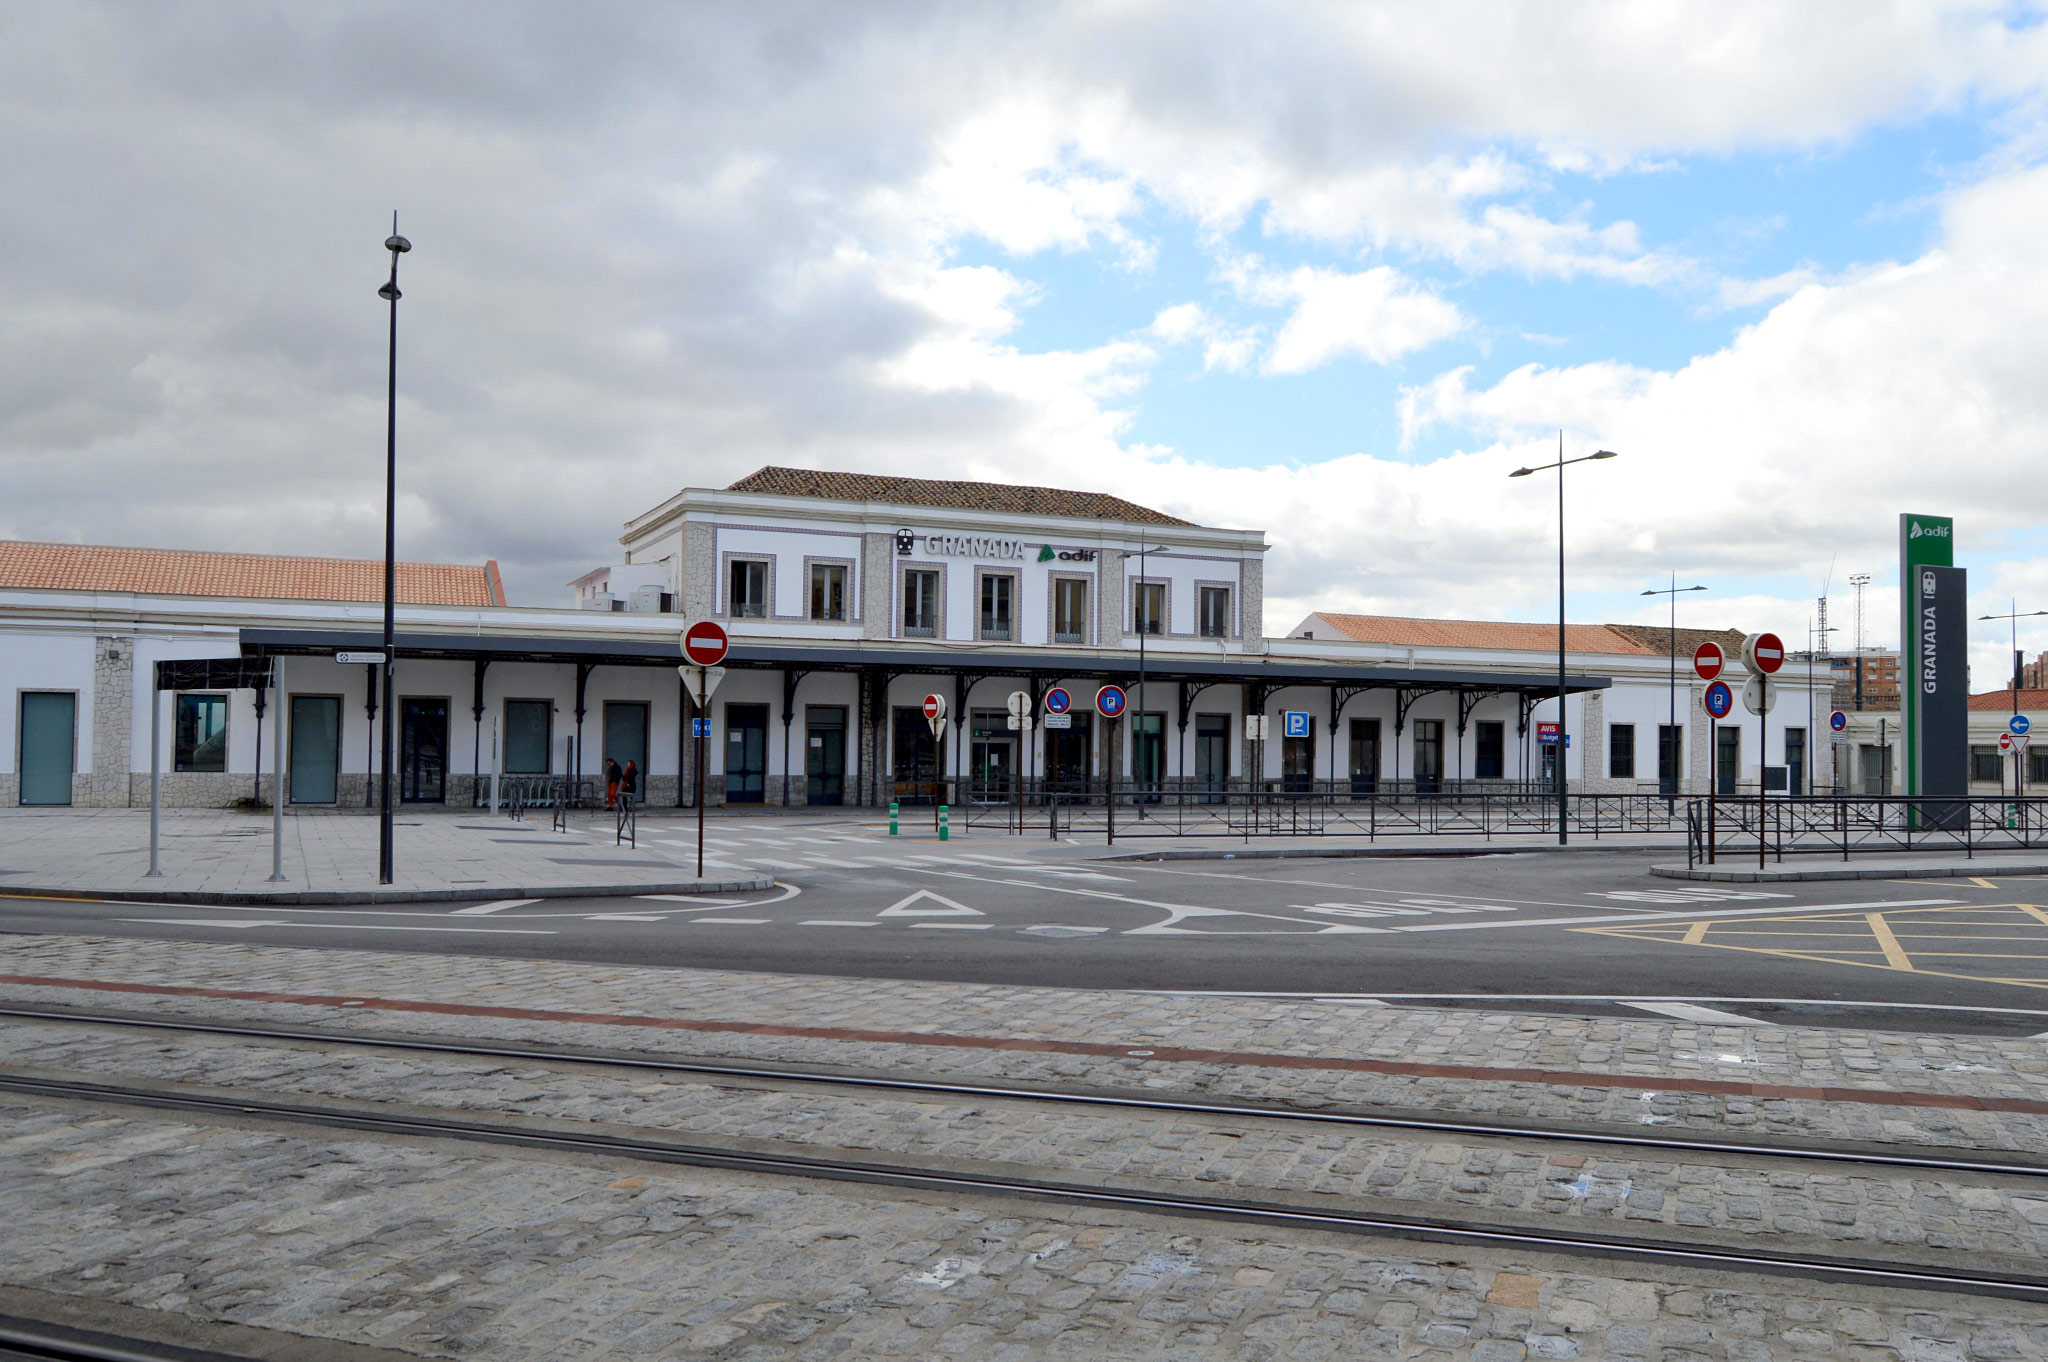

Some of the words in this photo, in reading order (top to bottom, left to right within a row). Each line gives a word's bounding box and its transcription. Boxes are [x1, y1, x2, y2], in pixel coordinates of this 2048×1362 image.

[1923, 525, 1950, 537] adif
[924, 534, 1025, 560] GRANADA
[1058, 549, 1098, 562] adif
[1923, 606, 1937, 694] GRANADA
[1715, 695, 1722, 703] P
[1290, 715, 1304, 733] P
[1543, 734, 1559, 742] Budget
